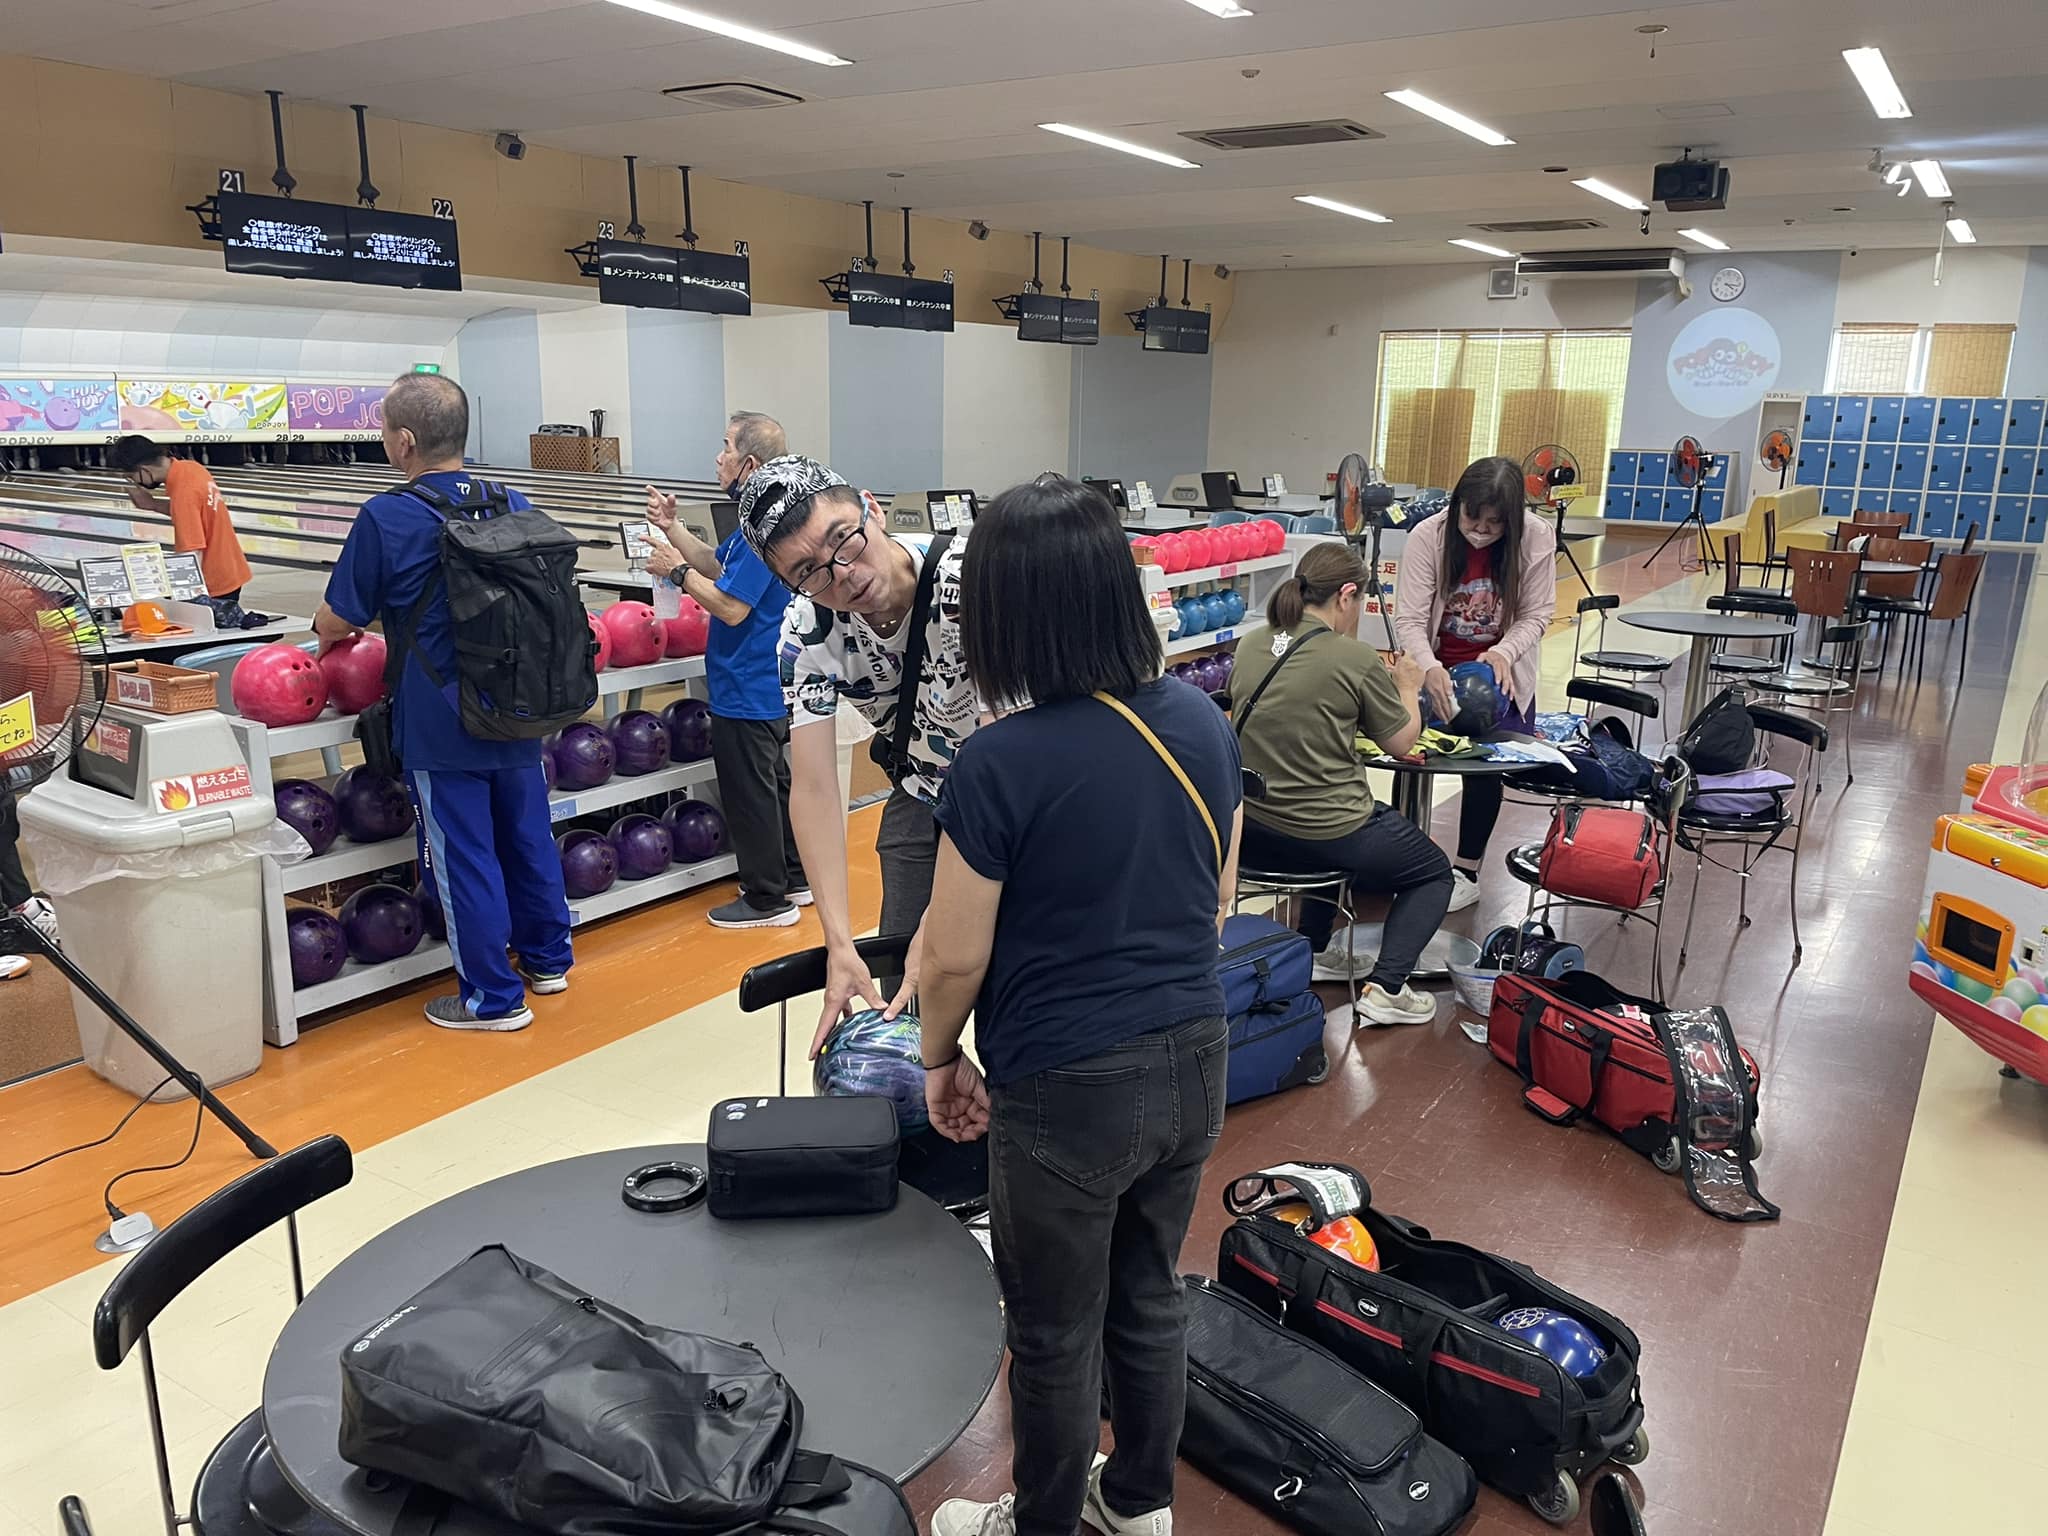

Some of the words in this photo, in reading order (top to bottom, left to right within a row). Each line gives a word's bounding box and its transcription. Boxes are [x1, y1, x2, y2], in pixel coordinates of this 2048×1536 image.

[221, 171, 242, 192] 21
[433, 200, 454, 218] 22
[599, 222, 614, 240] 23
[735, 242, 748, 256] 24
[852, 258, 863, 272] 25
[943, 270, 954, 284] 26
[1024, 281, 1033, 294] 27
[291, 386, 354, 419] POP
[353, 400, 385, 429] JO
[256, 421, 287, 429] POPJOY
[0, 436, 54, 445] POPJOY
[185, 434, 233, 442] POPJOY
[276, 433, 289, 442] 28
[293, 433, 305, 442] 29
[343, 433, 384, 442] POPJOY
[196, 767, 247, 789] 燃えるゴミ
[198, 788, 232, 804] BURNABLE
[231, 784, 253, 798] WASTE
